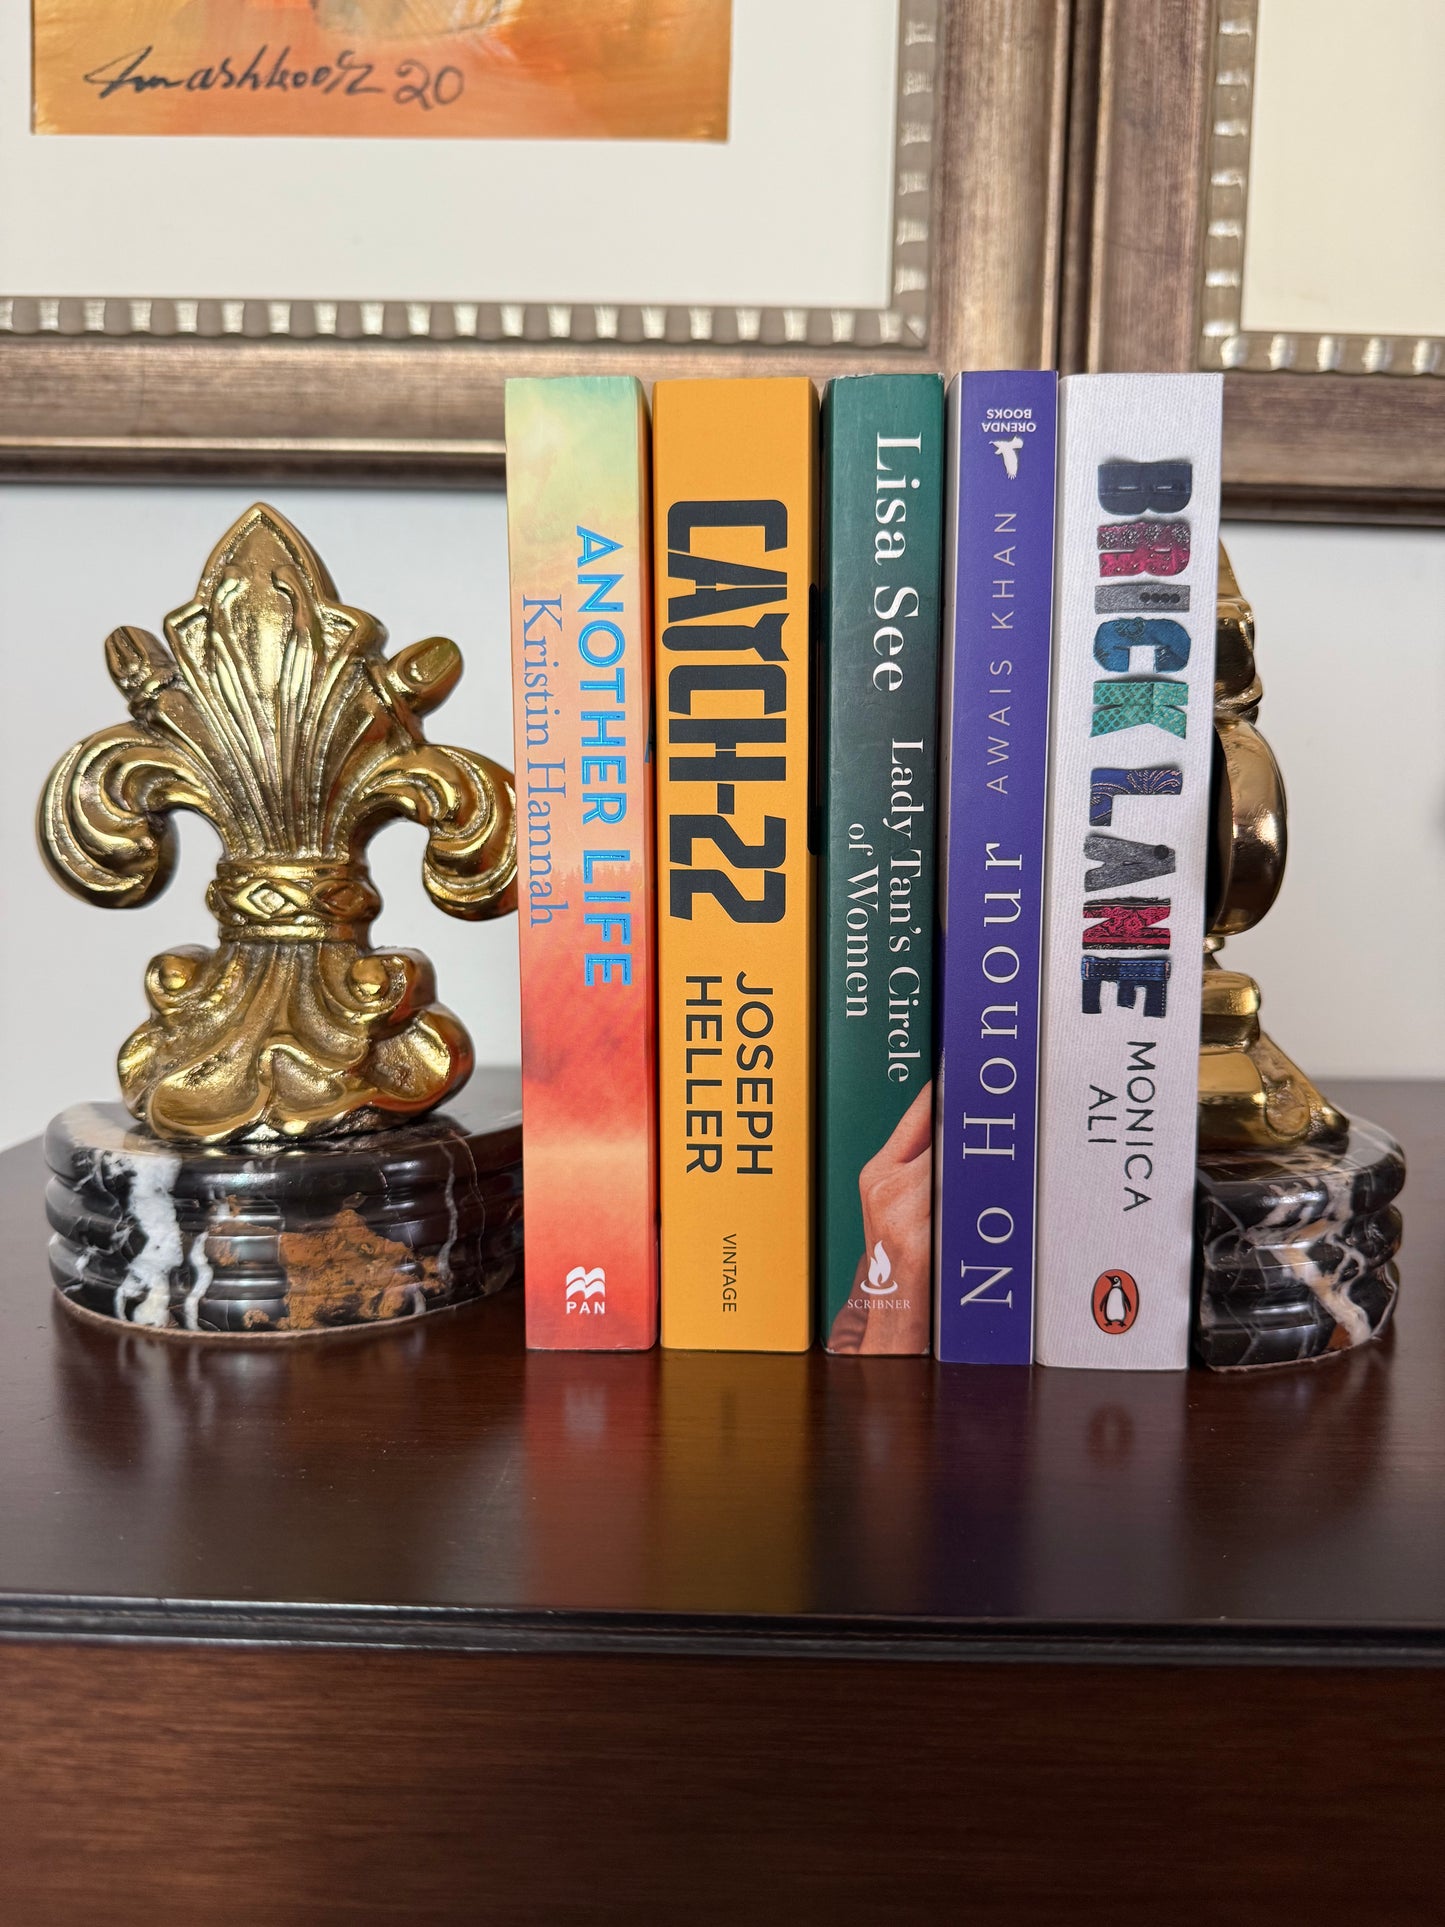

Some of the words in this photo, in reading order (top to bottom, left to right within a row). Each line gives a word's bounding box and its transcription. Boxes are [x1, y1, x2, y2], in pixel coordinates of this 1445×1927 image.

[393, 59, 465, 111] 20
[982, 422, 1036, 433] ORENDA
[987, 409, 1032, 419] BOOKS
[874, 431, 922, 567] Lisa
[871, 585, 920, 692] See
[991, 511, 1017, 630] KHAN
[1091, 461, 1193, 739] BRICK
[522, 593, 562, 748] Kristin
[575, 525, 628, 825] ANOTHER
[661, 500, 790, 923] CATCH-22
[985, 658, 1013, 795] AWAIS
[527, 756, 569, 927] Hannah
[848, 823, 876, 855] of
[882, 738, 925, 841] Lady
[581, 849, 632, 986] LIFE
[845, 857, 880, 1019] Women
[1080, 766, 1183, 1019] LANE
[886, 966, 922, 1083] Circle
[962, 842, 1024, 1160] Honour
[685, 975, 723, 1174] HELLER
[736, 970, 774, 1175] JOSEPH
[1086, 1084, 1118, 1144] ALI
[1122, 1041, 1157, 1212] MONICA
[565, 1301, 606, 1315] PAN
[722, 1233, 738, 1313] VINTAGE
[847, 1299, 911, 1310] SCRIBNER
[960, 1205, 1015, 1309] No
